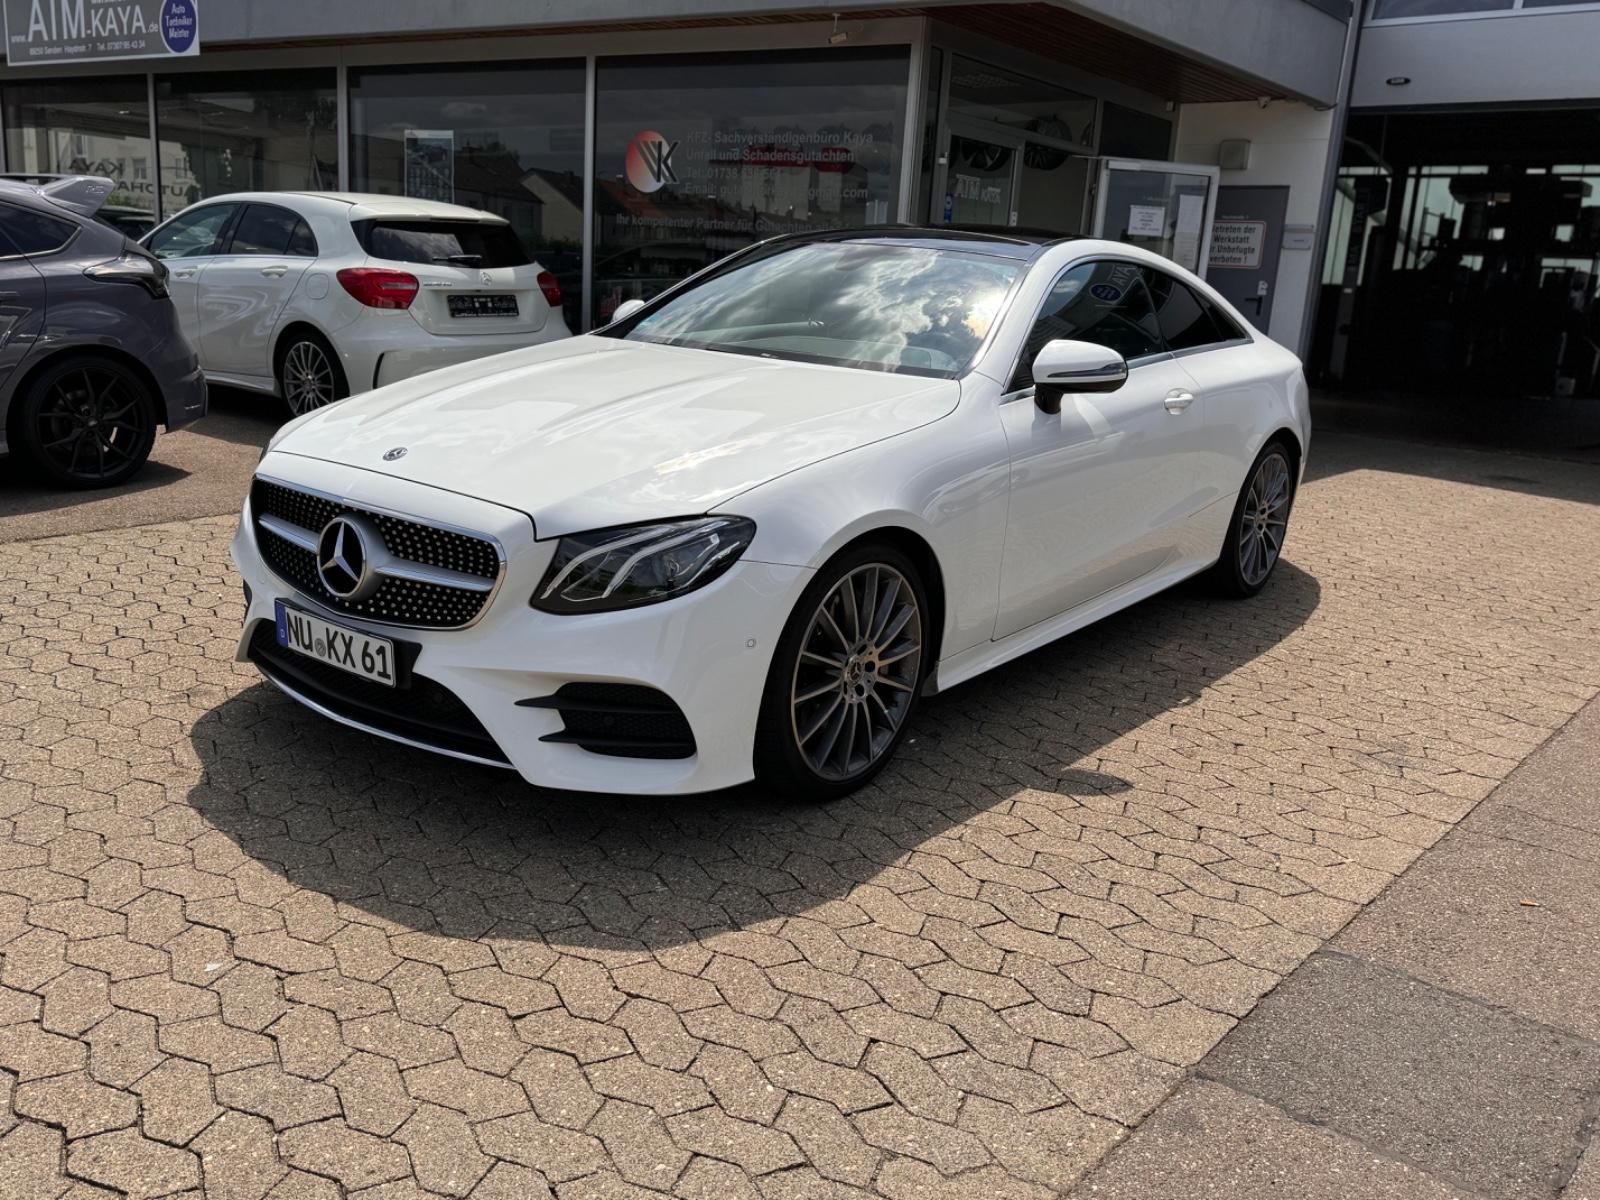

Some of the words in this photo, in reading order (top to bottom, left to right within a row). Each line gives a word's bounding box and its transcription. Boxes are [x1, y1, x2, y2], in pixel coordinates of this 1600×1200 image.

[171, 3, 186, 14] Auto
[165, 15, 193, 27] Techniker
[169, 27, 190, 39] Meister
[715, 130, 840, 146] Sachverständigenbüro
[843, 131, 874, 146] Kaya
[720, 150, 740, 162] und
[743, 149, 855, 164] Schadensgutachten
[616, 213, 628, 225] Ihr
[631, 213, 694, 230] kompetenter
[696, 218, 734, 232] Partner
[1243, 225, 1256, 234] der
[1213, 234, 1250, 244] Werkstatt
[286, 611, 313, 652] NU
[326, 627, 356, 668] KX
[361, 640, 391, 680] 61
